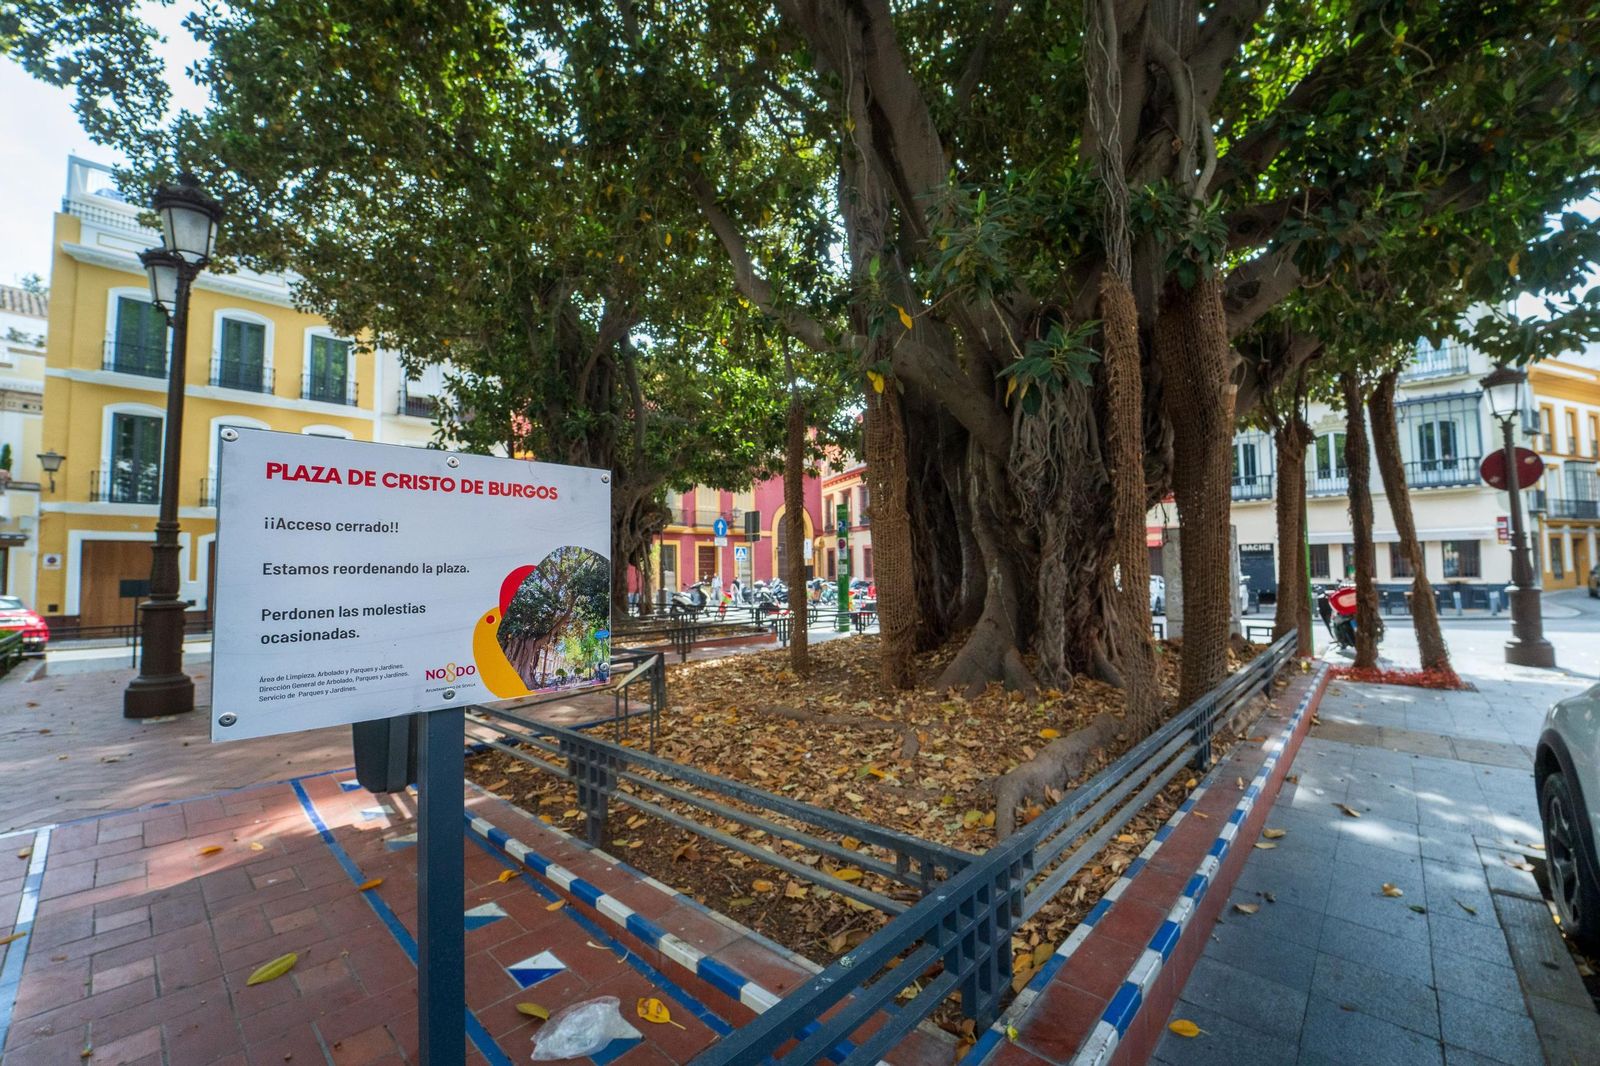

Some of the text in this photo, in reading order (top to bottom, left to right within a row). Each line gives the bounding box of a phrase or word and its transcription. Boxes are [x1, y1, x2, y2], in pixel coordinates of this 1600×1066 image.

[266, 462, 558, 500] PLAZA DE CRISTO DE BURGOS
[264, 517, 399, 533] ¡¡Acceso cerrado!!
[263, 562, 470, 576] Estamos reordenando la plaza.
[262, 602, 426, 621] Perdonen las molestias
[261, 628, 360, 644] ocasionadas.
[318, 670, 344, 678] Arbolado
[259, 684, 290, 692] Dirección
[292, 681, 316, 690] General
[326, 676, 354, 685] Arbolado,
[258, 694, 286, 702] Servicio
